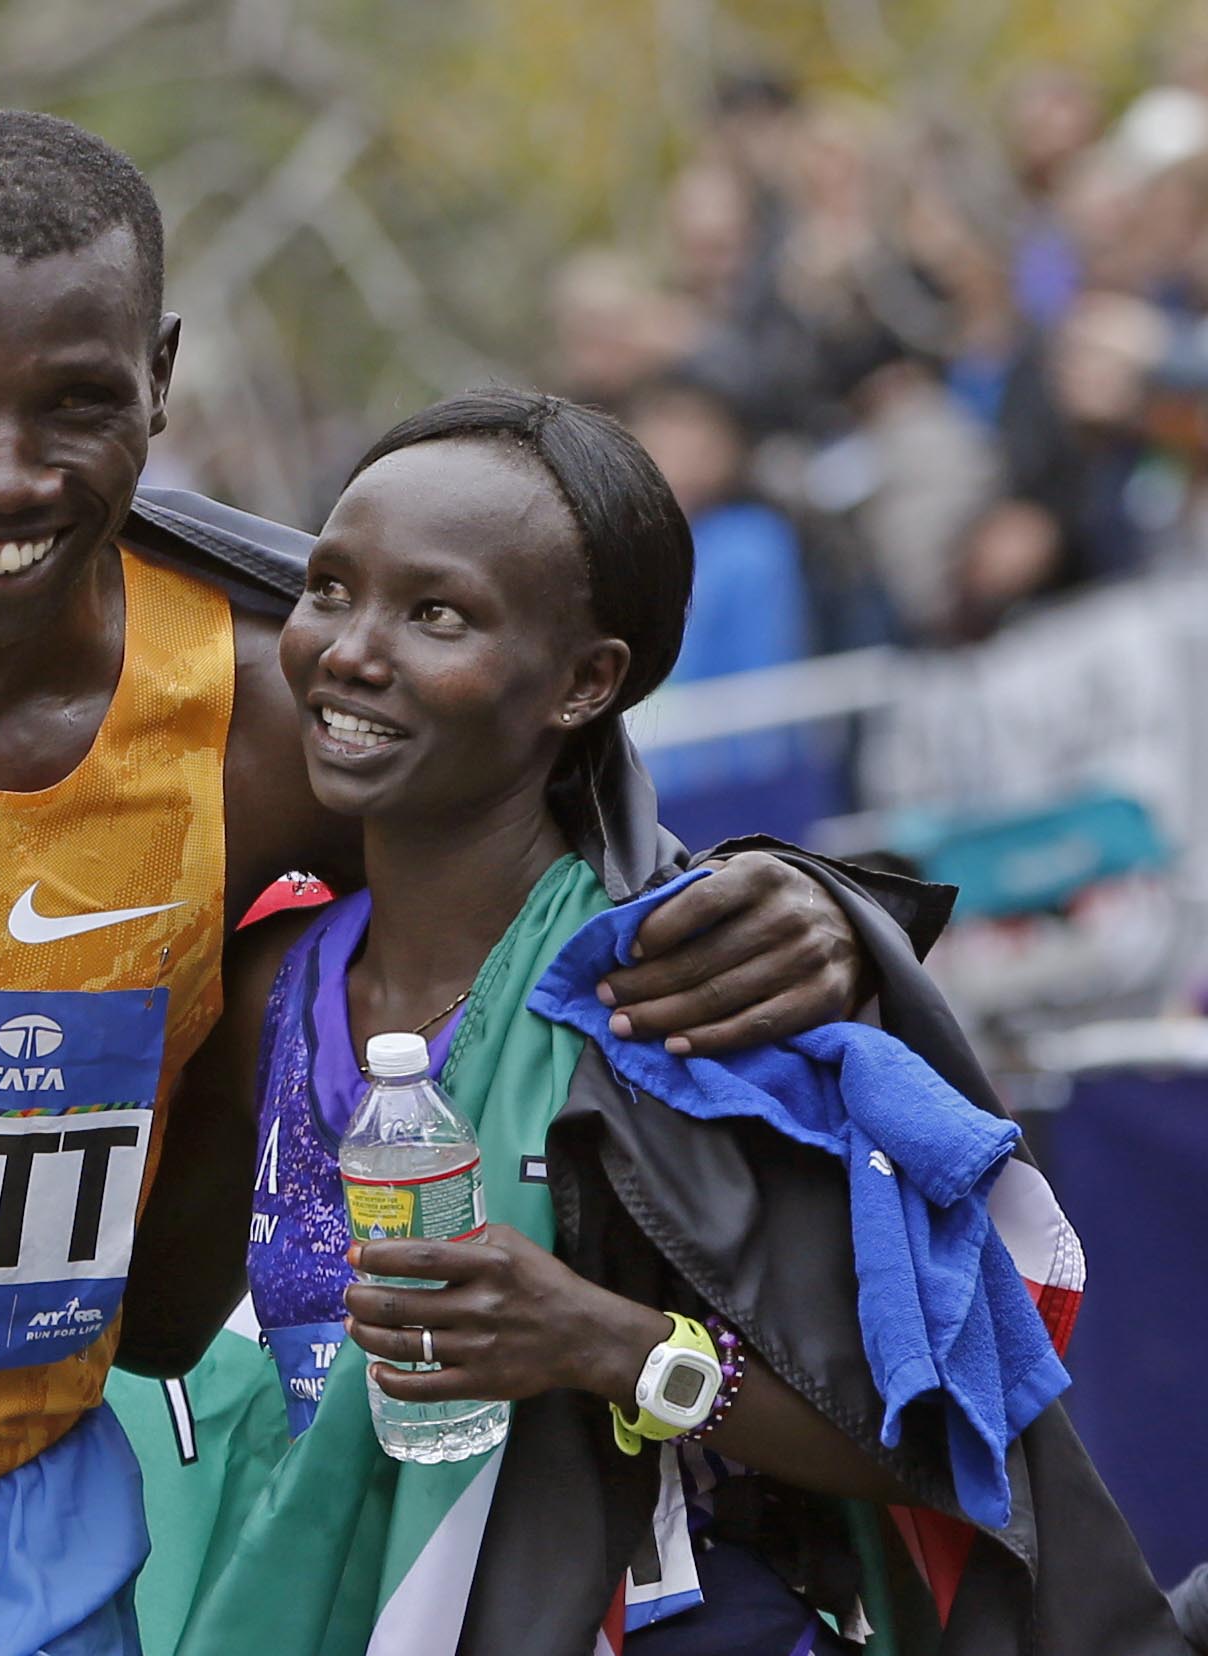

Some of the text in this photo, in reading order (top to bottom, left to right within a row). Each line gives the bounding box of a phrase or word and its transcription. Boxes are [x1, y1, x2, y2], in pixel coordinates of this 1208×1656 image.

[26, 1330, 50, 1341] RUN
[53, 1328, 76, 1338] FOR
[310, 1342, 341, 1369] TA
